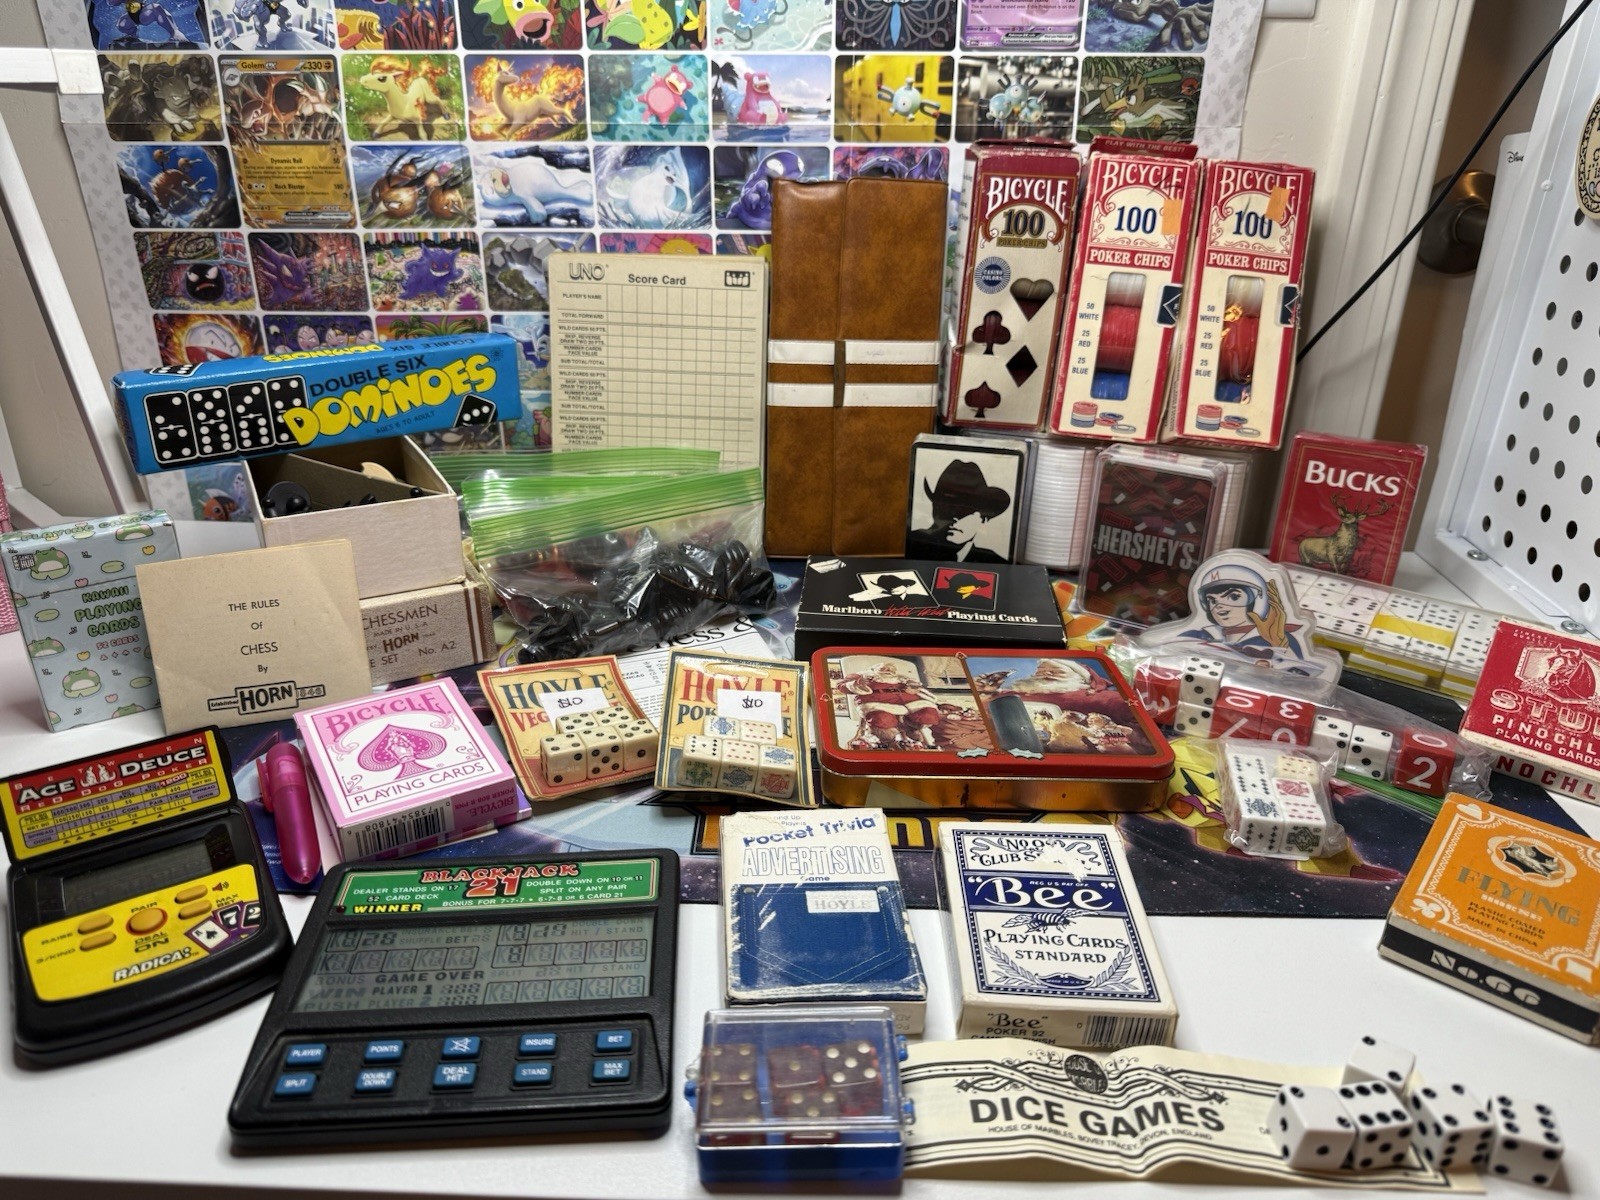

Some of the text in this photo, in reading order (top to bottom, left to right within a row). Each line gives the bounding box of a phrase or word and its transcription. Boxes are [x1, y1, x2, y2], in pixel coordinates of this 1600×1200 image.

[241, 62, 265, 70] Golem
[307, 61, 323, 70] 330
[1105, 139, 1124, 147] PLAY
[1126, 141, 1146, 149] WITH
[1162, 144, 1185, 153] BEST!
[1100, 161, 1184, 201] BICYCLE
[984, 176, 1069, 224] BICYCLE
[1000, 207, 1046, 239] 100
[1114, 205, 1157, 234] 100
[1232, 210, 1273, 240] 100
[1089, 248, 1171, 269] POKER CHIPS
[1208, 252, 1288, 273] POKER CHIPS
[568, 263, 606, 281] UNO
[628, 273, 687, 286] Score Card
[1086, 302, 1095, 310] 50
[1078, 312, 1100, 321] WHITE
[1200, 314, 1220, 324] WHITE
[1081, 329, 1090, 337] 25
[1078, 340, 1091, 348] RED
[1200, 342, 1213, 350] RED
[1200, 359, 1208, 367] 25
[309, 355, 428, 397] DOUBLE SIX
[1072, 366, 1089, 376] BLUE
[1195, 369, 1212, 378] BLUE
[402, 417, 412, 427] TO
[414, 411, 436, 423] ADULT
[1097, 524, 1196, 570] HERSHEY'S
[74, 597, 142, 622] PLAYING
[228, 599, 280, 612] THE RULES
[821, 603, 1038, 624] Marlboro Playing Cards
[87, 615, 140, 637] CARDS
[250, 621, 263, 631] Of
[240, 641, 279, 656] CHESS
[382, 632, 419, 654] HORN
[441, 641, 457, 652] A2
[381, 653, 399, 666] SET
[257, 664, 269, 674] By
[239, 684, 293, 712] HORN
[325, 691, 446, 742] BICYCLE
[1492, 714, 1600, 756] PINOCHL
[1495, 728, 1600, 767] PLAYING CARDS
[18, 746, 207, 804] ACE DEUCE
[1496, 755, 1598, 800] NOCHL
[354, 761, 485, 806] PLAYING CARDS
[742, 825, 815, 848] Pocket
[819, 816, 876, 835] Trivia
[742, 845, 885, 877] ADVERTISING
[979, 853, 1021, 867] CLUB
[421, 863, 579, 883] BLACKJACK
[466, 876, 521, 898] 21
[526, 879, 562, 887] DOUBLE
[215, 893, 239, 903] MAX
[353, 887, 389, 895] DEALER
[1457, 865, 1581, 927] FLYING
[130, 901, 158, 913] PAIR
[353, 903, 423, 914] WINNER
[477, 898, 497, 906] FOR
[813, 899, 872, 911] HOYLE
[134, 931, 167, 945] DEAL
[1466, 915, 1491, 928] MADE
[1508, 931, 1538, 947] CHINA
[133, 938, 170, 953] ON
[445, 935, 469, 944] BET
[983, 929, 1128, 949] PLAYING CARDS
[1015, 949, 1107, 963] STANDARD
[375, 970, 485, 984] GAME OVER
[372, 985, 433, 995] PLAYER 1
[986, 1028, 1027, 1036] POKER
[370, 1045, 399, 1053] POINTS
[525, 1038, 554, 1046] INSURE
[362, 1072, 392, 1080] DOUBLE
[442, 1066, 469, 1075] DEAL
[521, 1068, 548, 1076] STAND
[284, 1078, 308, 1087] SPLIT
[446, 1074, 463, 1082] HIT
[969, 1095, 1226, 1138] DICE GAMES
[987, 1124, 1019, 1133] HOUSE
[1021, 1123, 1032, 1131] OF
[1171, 1127, 1214, 1140] ENGLAND
